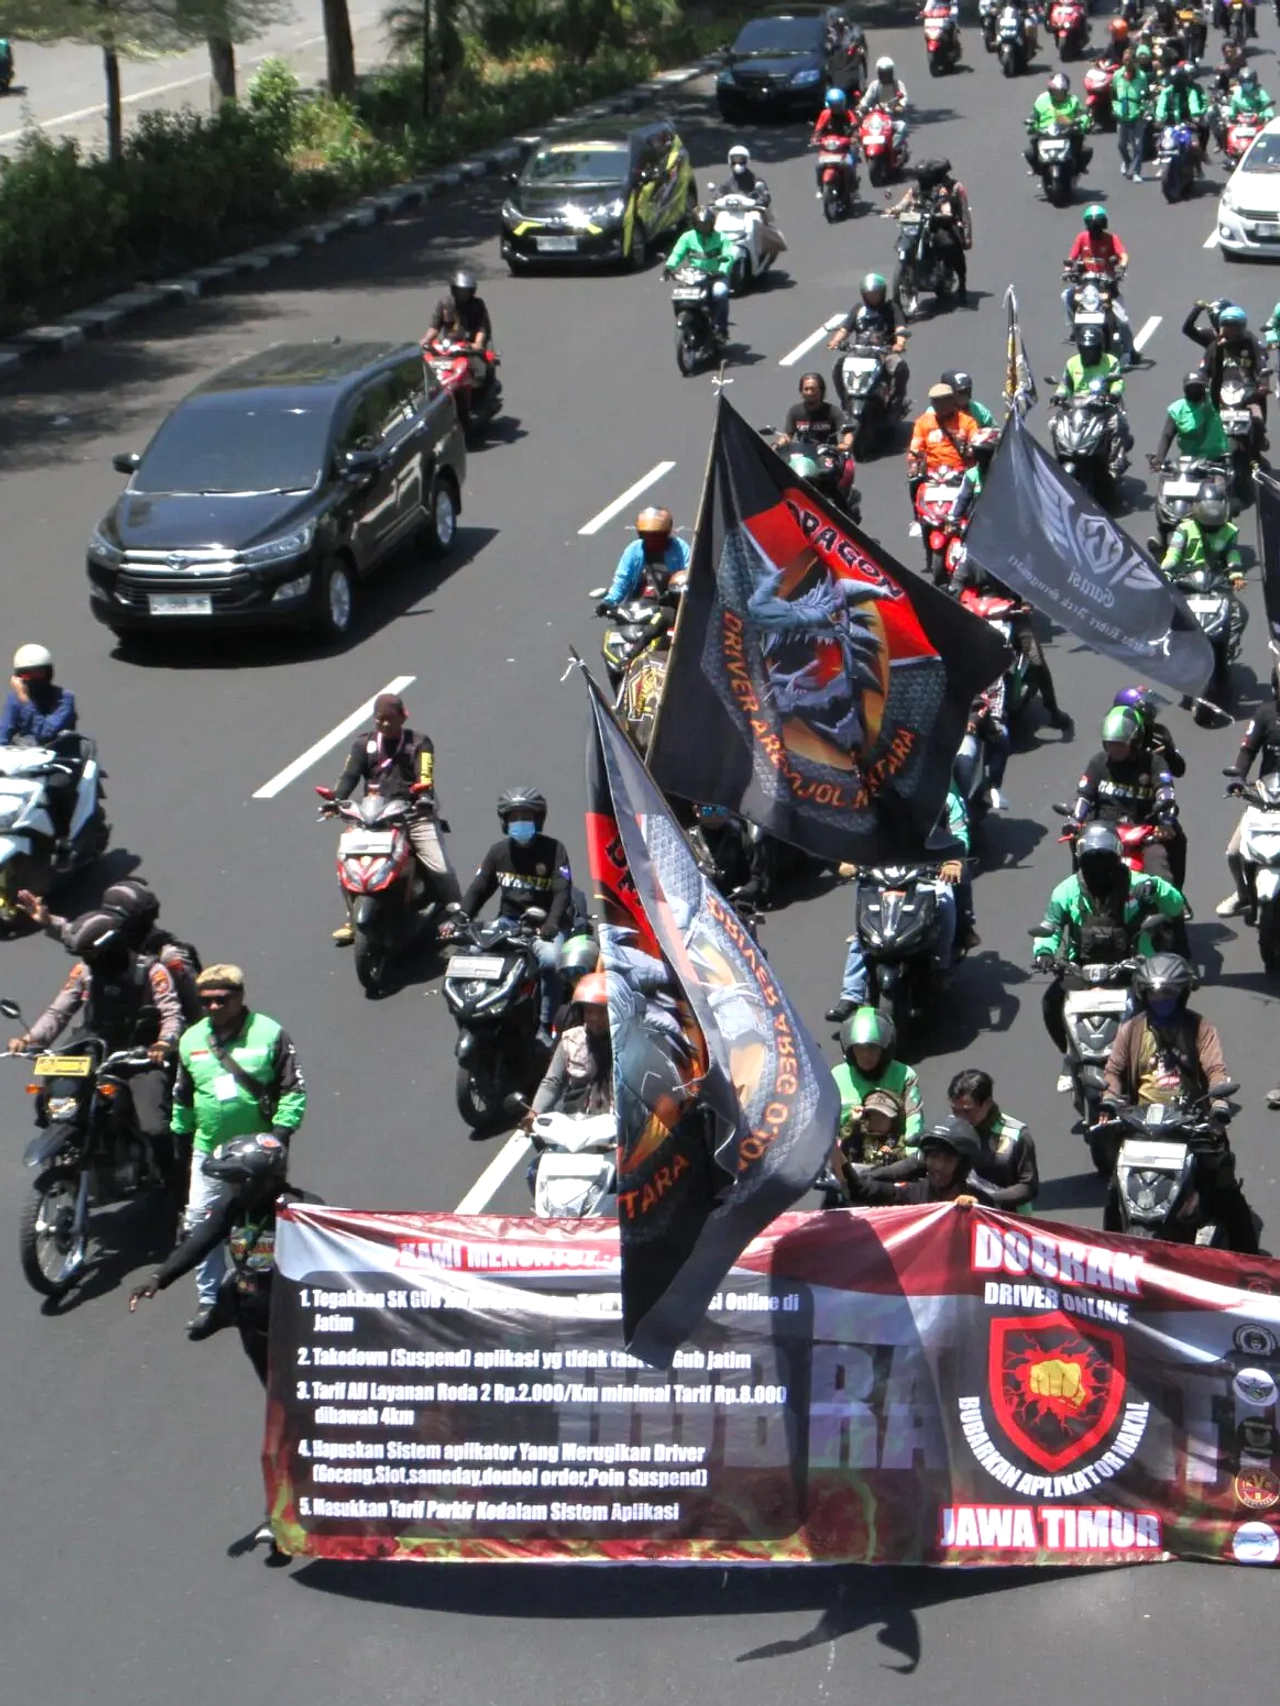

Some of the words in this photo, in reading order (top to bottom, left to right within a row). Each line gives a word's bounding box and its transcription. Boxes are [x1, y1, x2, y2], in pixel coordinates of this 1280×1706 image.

[974, 1223, 1146, 1295] DOBRAK
[300, 1290, 310, 1308] 1.
[312, 1289, 386, 1309] Tegakkan
[387, 1290, 408, 1308] SK
[725, 1292, 779, 1311] Online
[783, 1293, 799, 1311] di
[984, 1281, 1059, 1309] DRIVER
[1062, 1292, 1129, 1325] ONLINE
[313, 1313, 354, 1332] Jatim
[297, 1347, 311, 1366] 2.
[312, 1347, 388, 1367] Takedown
[390, 1348, 471, 1369] (Suspend)
[473, 1349, 540, 1369] aplikasi
[542, 1351, 562, 1370] yg
[565, 1350, 608, 1369] tidak
[707, 1350, 752, 1371] jatim
[296, 1381, 310, 1400] 3.
[311, 1381, 346, 1400] Tarif
[347, 1382, 368, 1401] All
[370, 1382, 434, 1402] Layanan
[437, 1383, 478, 1402] Roda
[480, 1384, 491, 1402] 2
[494, 1383, 598, 1404] Rp.2.000/Km
[601, 1384, 670, 1403] minimal
[673, 1384, 712, 1403] Tarif
[714, 1385, 787, 1405] Rp.8.000
[314, 1406, 379, 1425] dibawah
[380, 1407, 414, 1426] 4km
[297, 1439, 311, 1457] 4.
[313, 1439, 384, 1460] Hapuskan
[387, 1441, 441, 1460] Sistem
[444, 1442, 516, 1462] aplikator
[519, 1443, 559, 1463] Yang
[562, 1444, 651, 1464] Merugikan
[653, 1445, 706, 1462] Driver
[958, 1396, 1022, 1489] BUBARKAN
[1015, 1451, 1126, 1498] APLIKATOR
[1110, 1401, 1150, 1459] NAKAL
[299, 1498, 312, 1516] 5.
[313, 1498, 388, 1518] Masukkan
[389, 1499, 425, 1519] Tarif
[426, 1500, 475, 1520] Parkir
[476, 1501, 548, 1521] Kedalam
[550, 1502, 608, 1521] Sistem
[611, 1502, 680, 1522] Aplikasi
[940, 1507, 1037, 1548] JAWA
[1042, 1508, 1161, 1548] TIMUR
